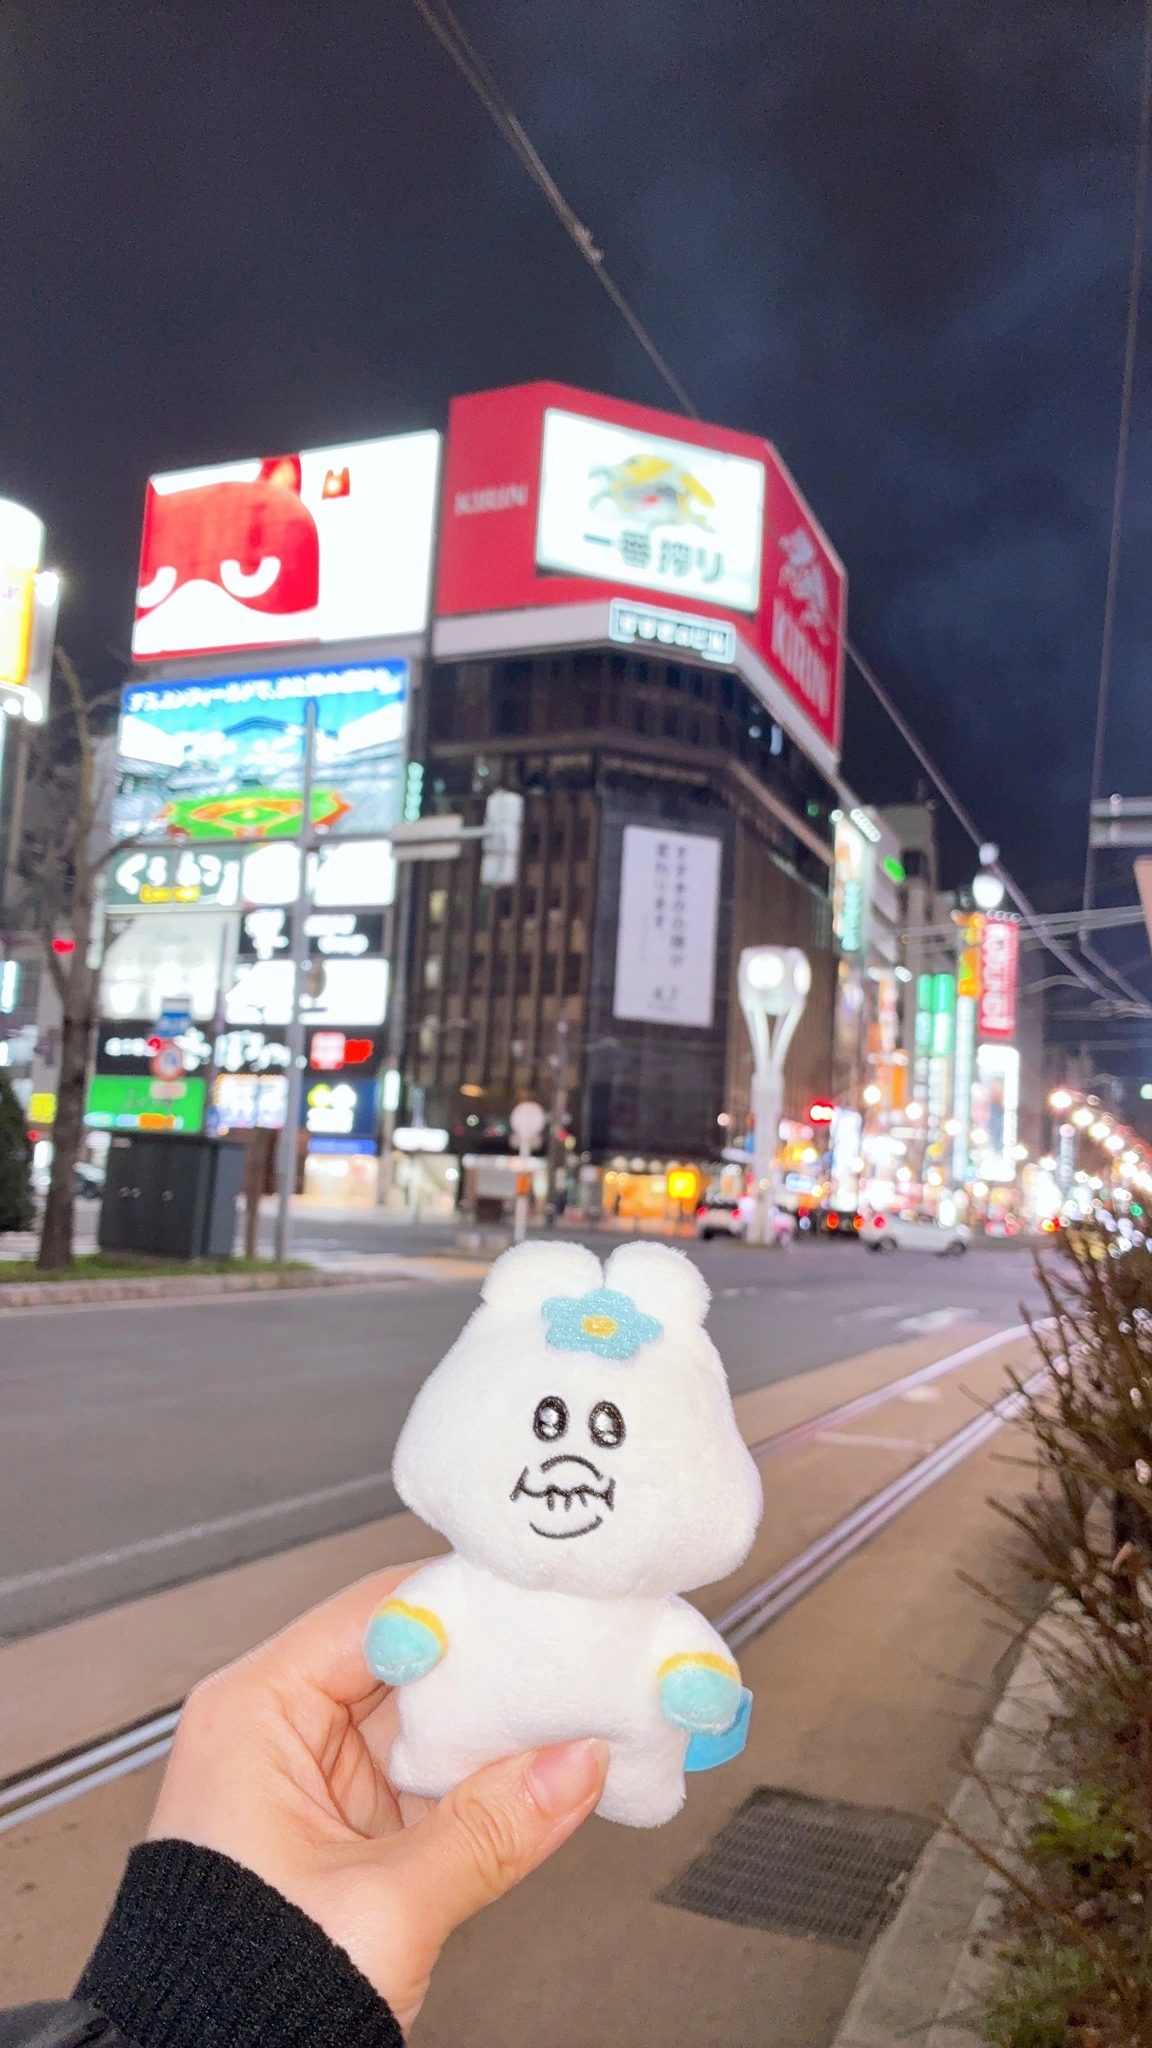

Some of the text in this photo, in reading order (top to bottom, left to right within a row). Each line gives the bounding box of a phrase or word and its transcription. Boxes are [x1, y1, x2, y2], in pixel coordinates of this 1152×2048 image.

[455, 484, 529, 516] KIRIN
[583, 529, 725, 584] 一番搾り
